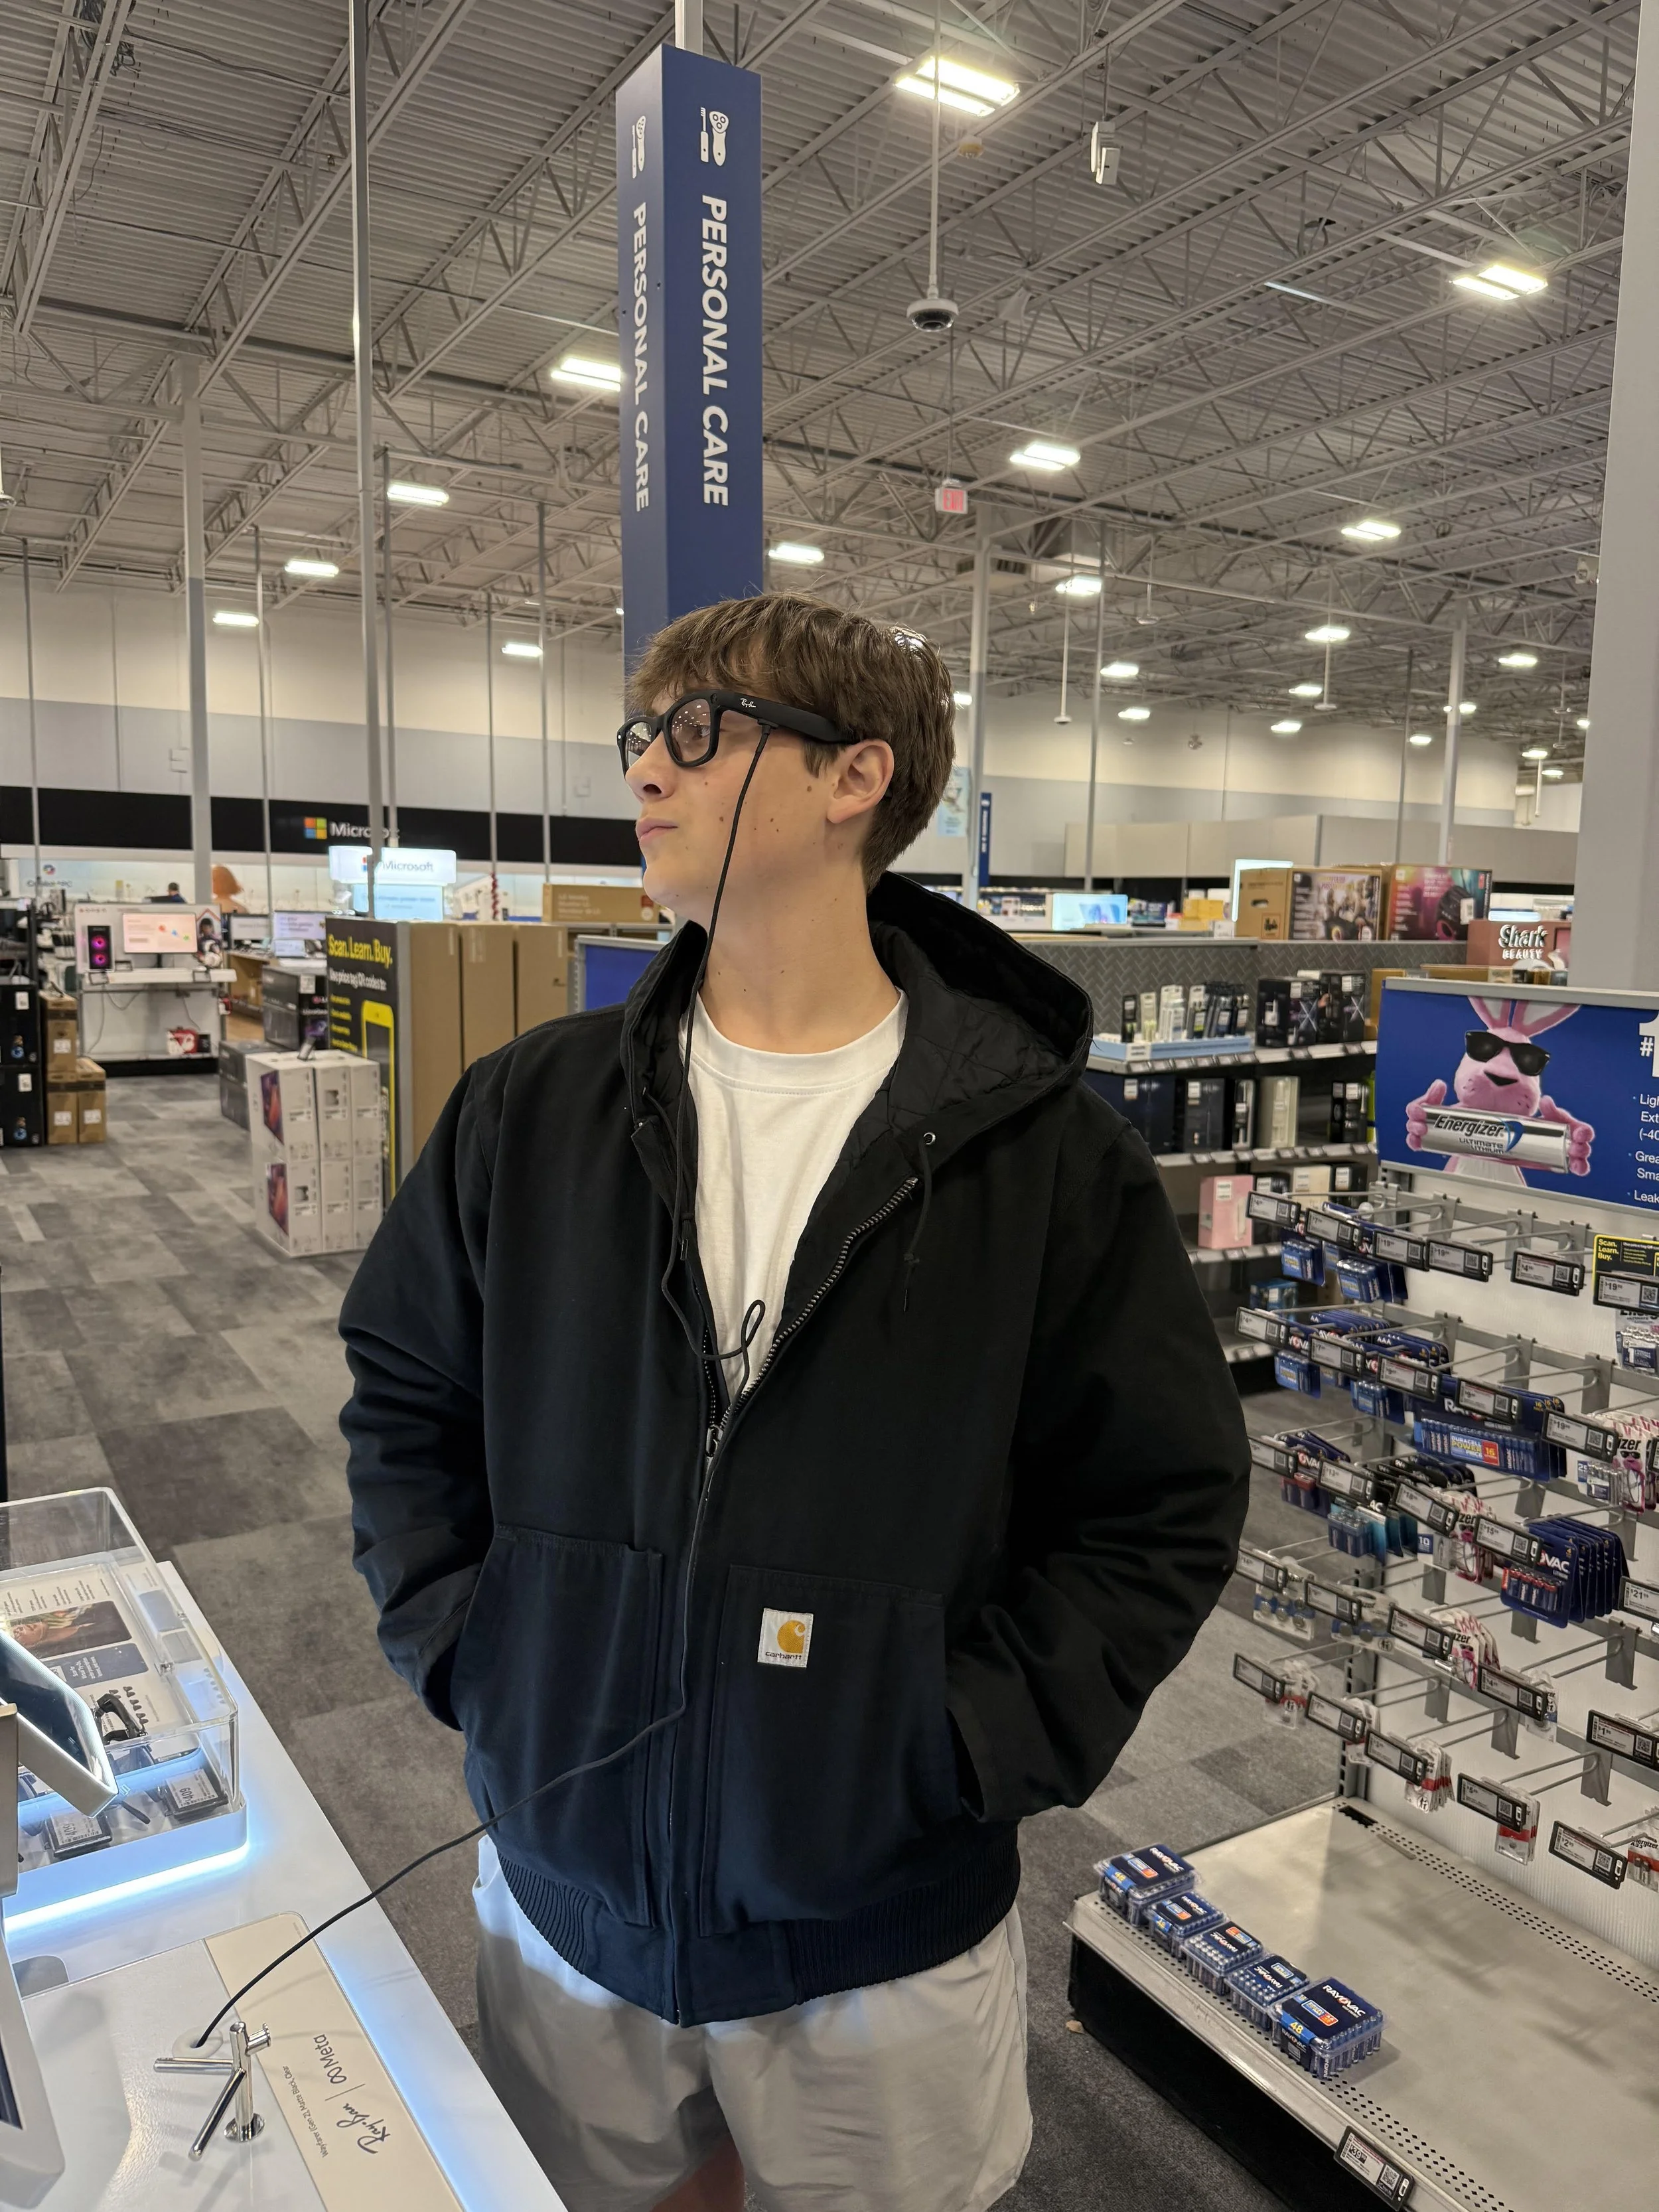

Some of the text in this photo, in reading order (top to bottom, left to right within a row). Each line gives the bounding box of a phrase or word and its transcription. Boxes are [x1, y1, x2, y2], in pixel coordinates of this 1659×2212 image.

[632, 202, 649, 512] PERSONAL CARE
[701, 194, 729, 507] PERSONAL CARE
[1498, 924, 1548, 948] Shark
[328, 934, 393, 969] Scan. Learn. Buy.
[1502, 949, 1544, 960] BEAUTY
[1434, 1115, 1504, 1138] Energizer
[1598, 1239, 1617, 1248] Scan.
[1598, 1246, 1619, 1254] Learn.
[1597, 1252, 1613, 1261] Buy.
[1377, 1336, 1392, 1345] AAA
[1451, 1441, 1482, 1453] POWER
[1485, 1447, 1494, 1456] 16
[765, 1651, 802, 1660] carhartt
[1254, 1966, 1283, 1988] RAYOVAC
[1323, 1984, 1366, 2016] RAYOVAC
[1289, 2022, 1303, 2034] 48
[313, 2034, 338, 2069] Meta
[283, 2065, 292, 2079] Clear
[288, 2078, 299, 2095] Black,
[297, 2094, 307, 2112] Matte
[307, 2119, 317, 2134] (Gen
[313, 2131, 328, 2158] Wayfarer
